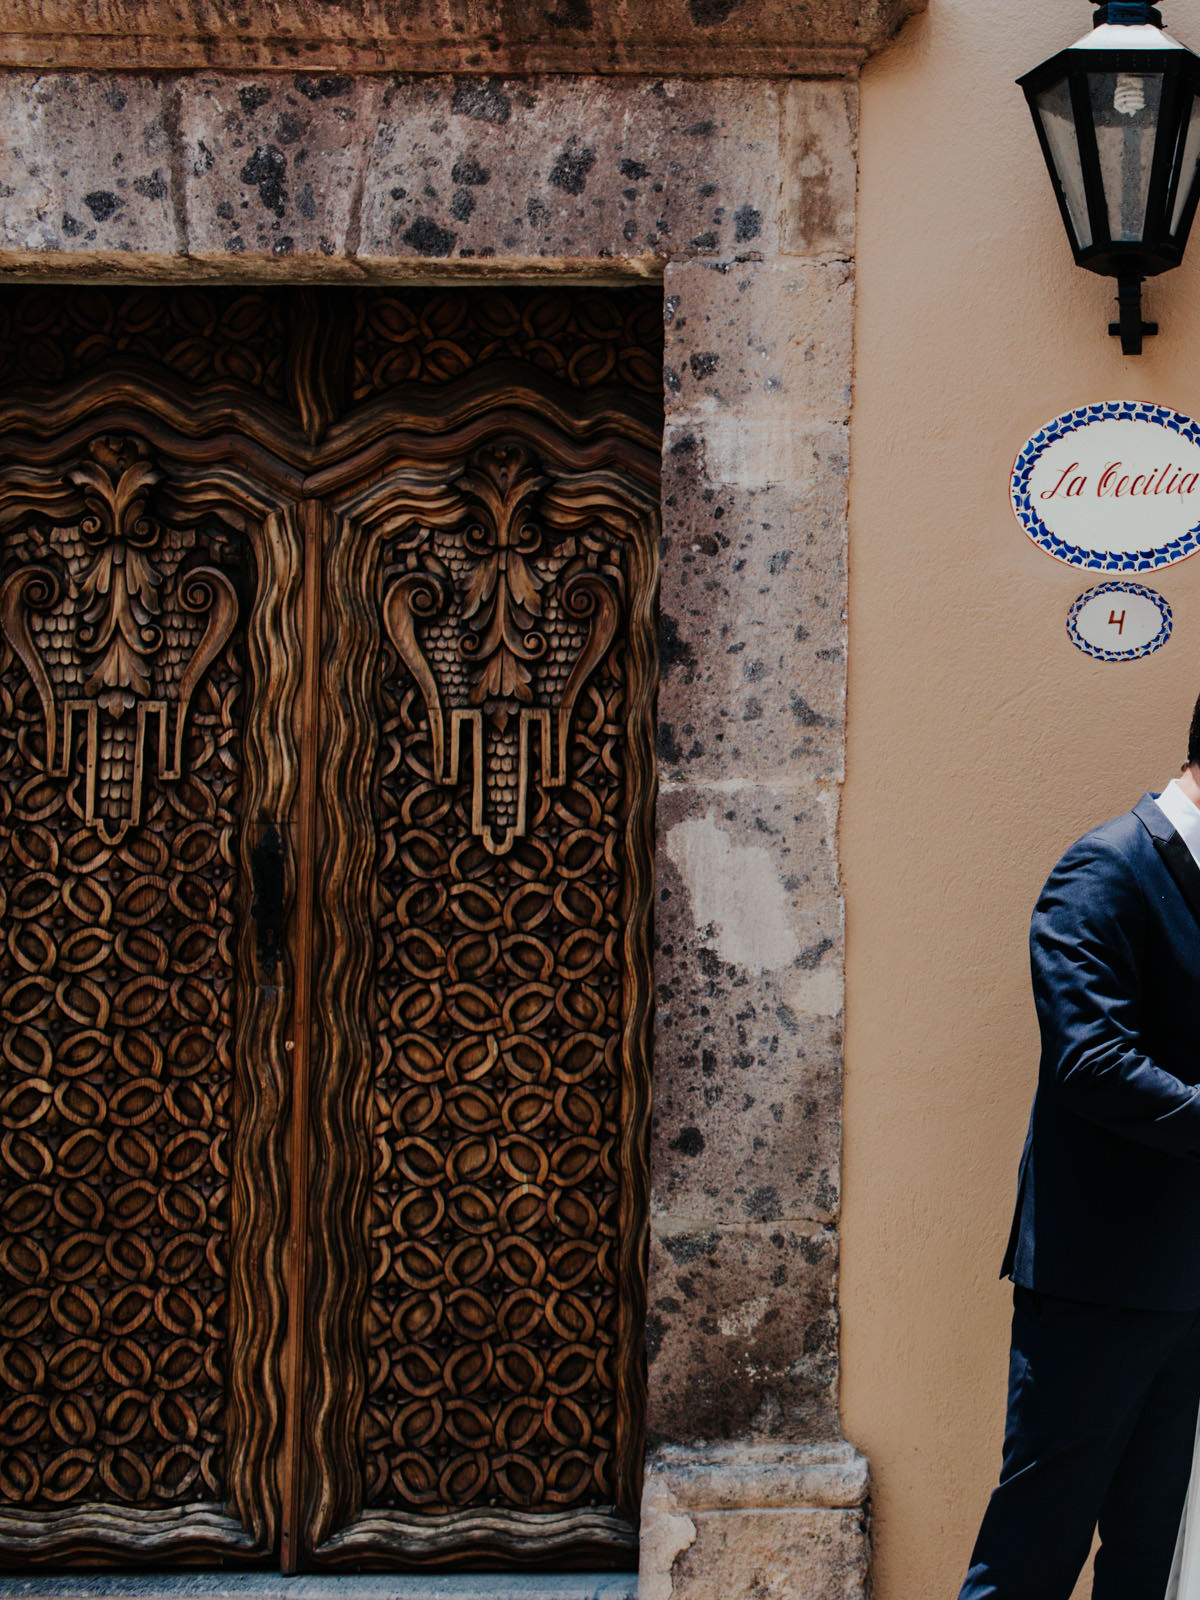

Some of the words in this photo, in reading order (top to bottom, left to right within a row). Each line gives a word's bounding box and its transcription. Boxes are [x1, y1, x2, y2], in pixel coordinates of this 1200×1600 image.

[1040, 462, 1088, 500] La
[1097, 461, 1200, 498] Cecilia
[1108, 609, 1126, 635] 4
